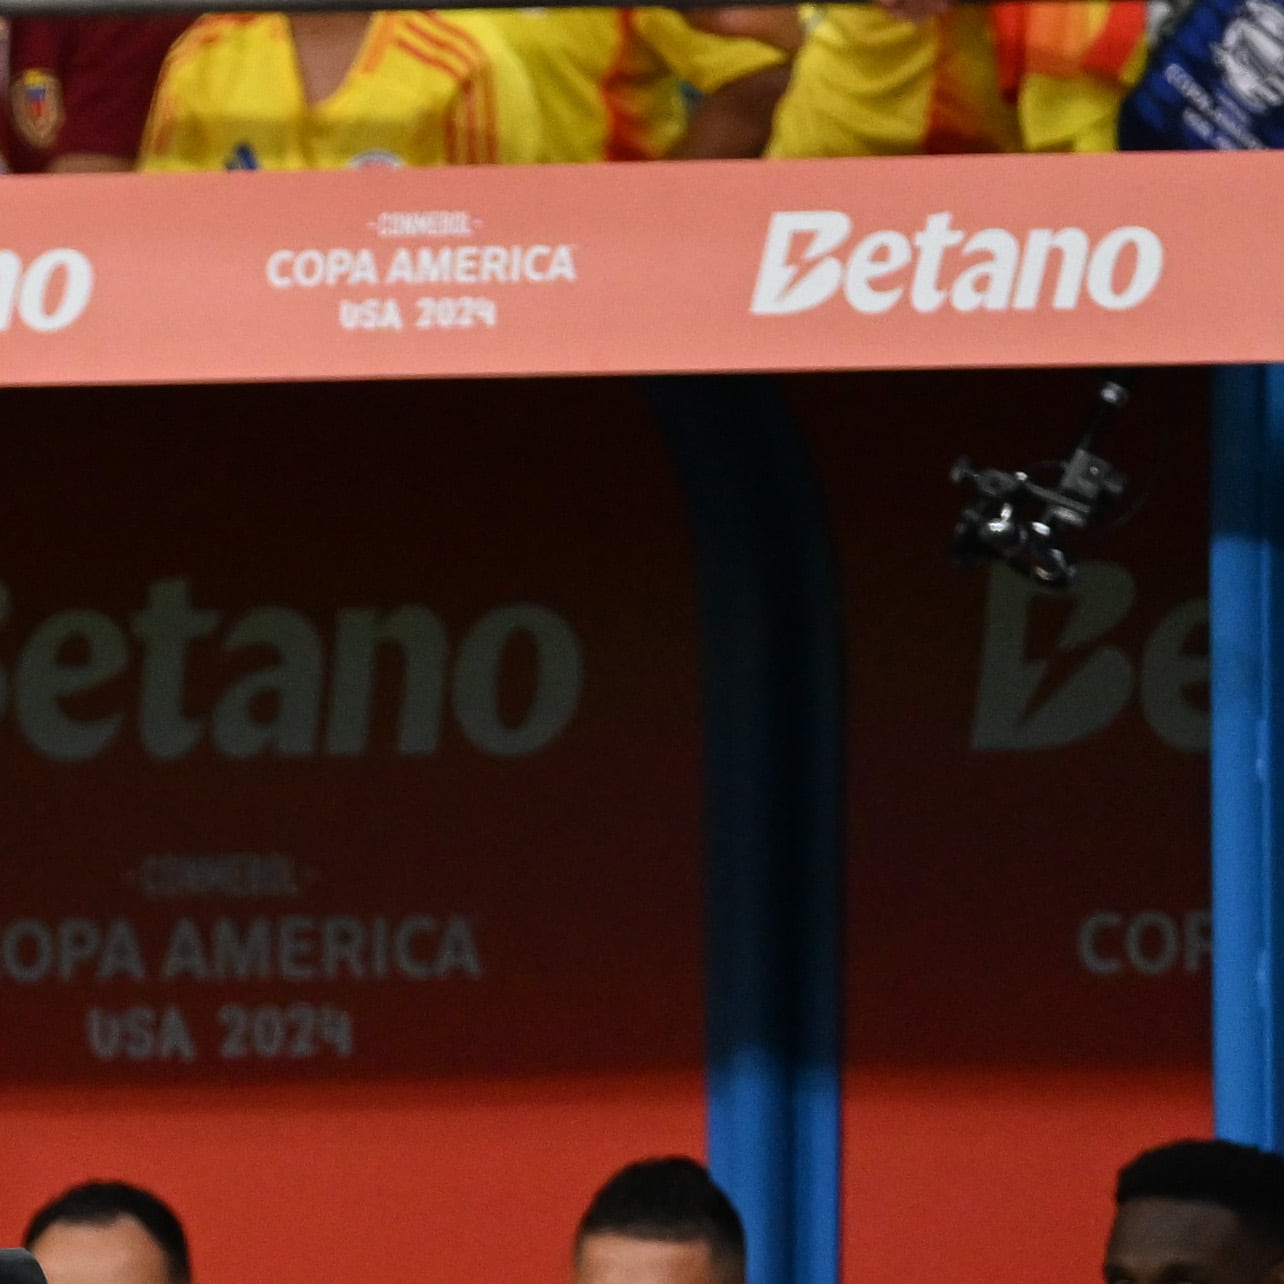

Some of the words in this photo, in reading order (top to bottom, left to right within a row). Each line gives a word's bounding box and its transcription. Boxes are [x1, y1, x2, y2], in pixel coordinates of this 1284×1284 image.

[267, 249, 377, 288] COPA
[386, 244, 577, 284] AMERICA
[750, 209, 1164, 315] Betano
[339, 299, 403, 330] USA
[415, 297, 496, 328] 2024
[163, 913, 482, 981] AMERICA
[1078, 910, 1212, 976] COP
[86, 1008, 195, 1061] USA
[218, 1005, 351, 1058] 2024
